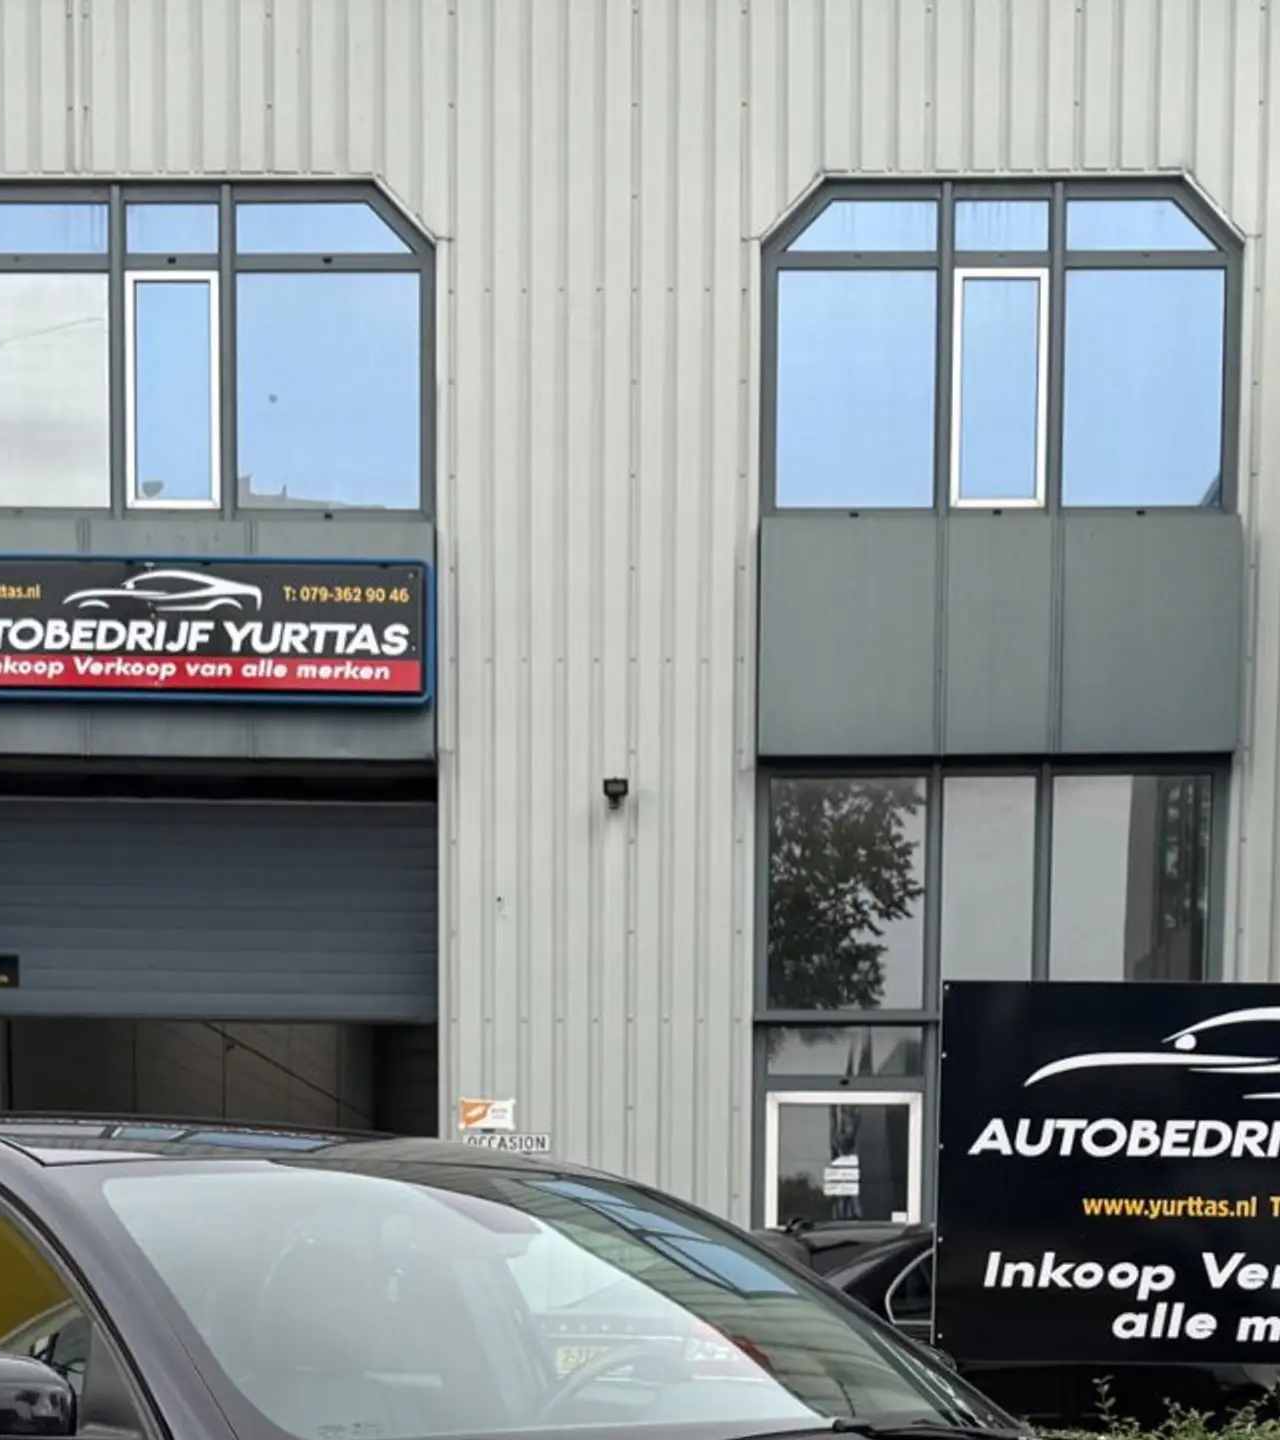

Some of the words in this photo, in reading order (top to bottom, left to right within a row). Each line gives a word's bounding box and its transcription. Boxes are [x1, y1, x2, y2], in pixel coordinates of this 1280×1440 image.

[283, 585, 297, 602] T:
[299, 586, 362, 602] 079-362
[365, 588, 387, 603] 90
[388, 588, 410, 604] 46
[224, 621, 410, 657] YURTTAS
[74, 657, 177, 681] Verkoop
[185, 662, 233, 678] van
[241, 659, 288, 679] alle
[296, 661, 391, 681] merken
[467, 1136, 546, 1150] OCCASION
[1082, 1194, 1258, 1219] www.yurttas.nl
[983, 1251, 1176, 1300] Inkoop
[1112, 1302, 1217, 1342] alle
